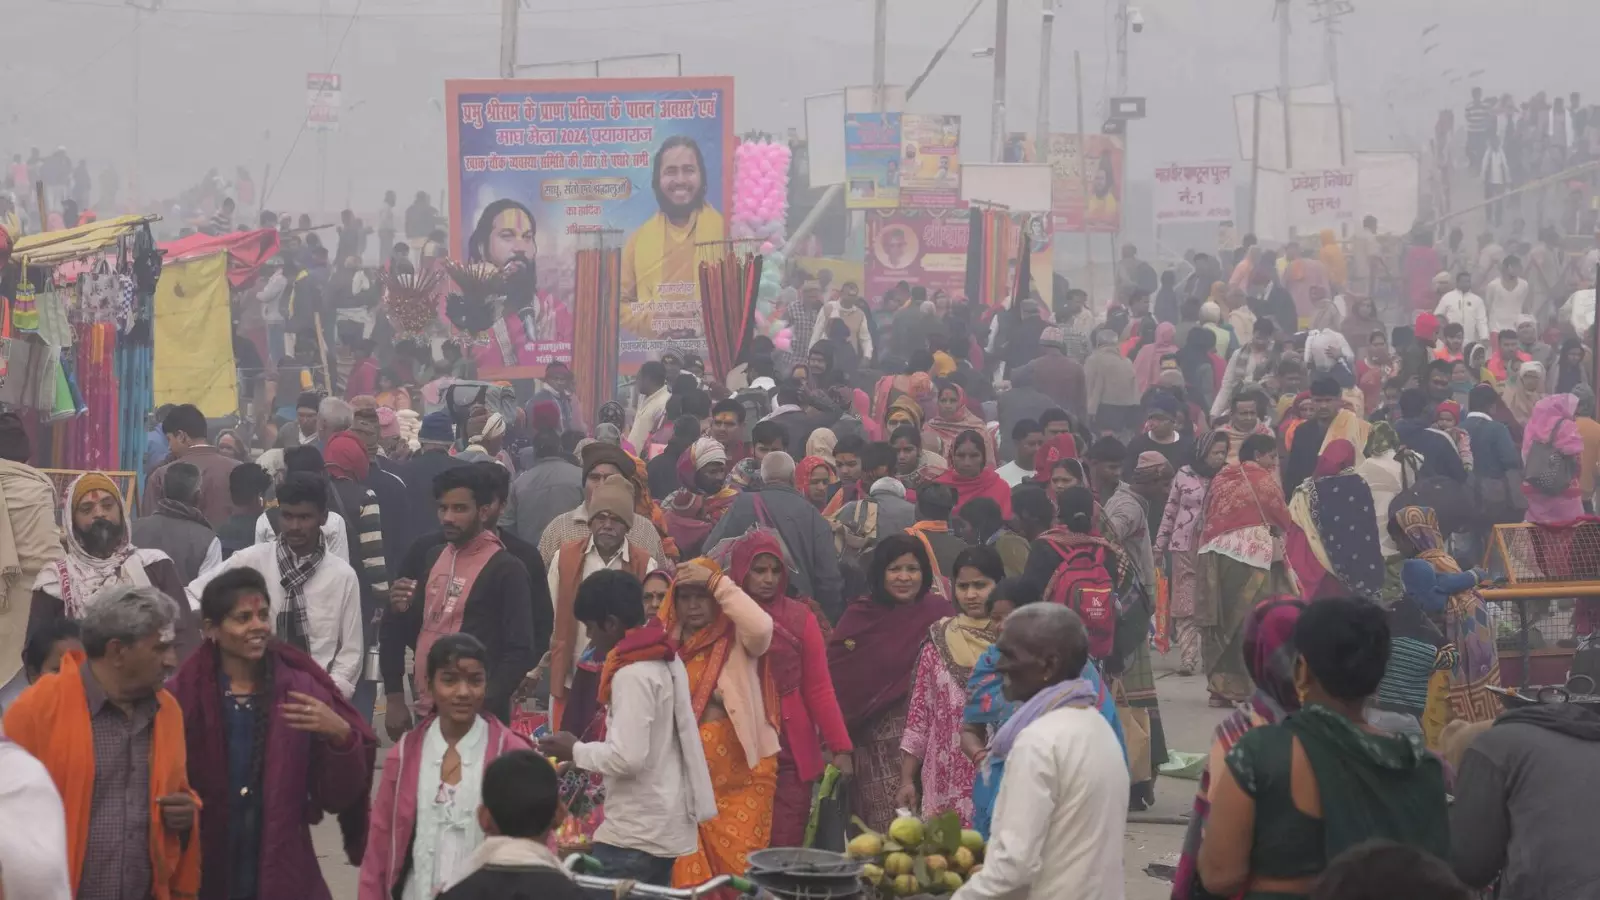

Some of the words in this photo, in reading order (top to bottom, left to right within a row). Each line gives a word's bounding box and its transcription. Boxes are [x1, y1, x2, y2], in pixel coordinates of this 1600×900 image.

[462, 101, 483, 129] प्रभु
[485, 97, 520, 122] श्रीराम
[524, 97, 536, 121] के
[540, 100, 566, 122] प्राण
[610, 97, 622, 121] के
[625, 100, 655, 120] पावन
[659, 98, 695, 120] अवसर
[496, 127, 525, 145] माघ
[527, 124, 556, 145] मेला
[561, 128, 588, 145] 2024
[592, 127, 652, 145] प्रयागराज
[540, 152, 566, 170] समिति
[568, 151, 579, 168] की
[600, 152, 608, 168] से
